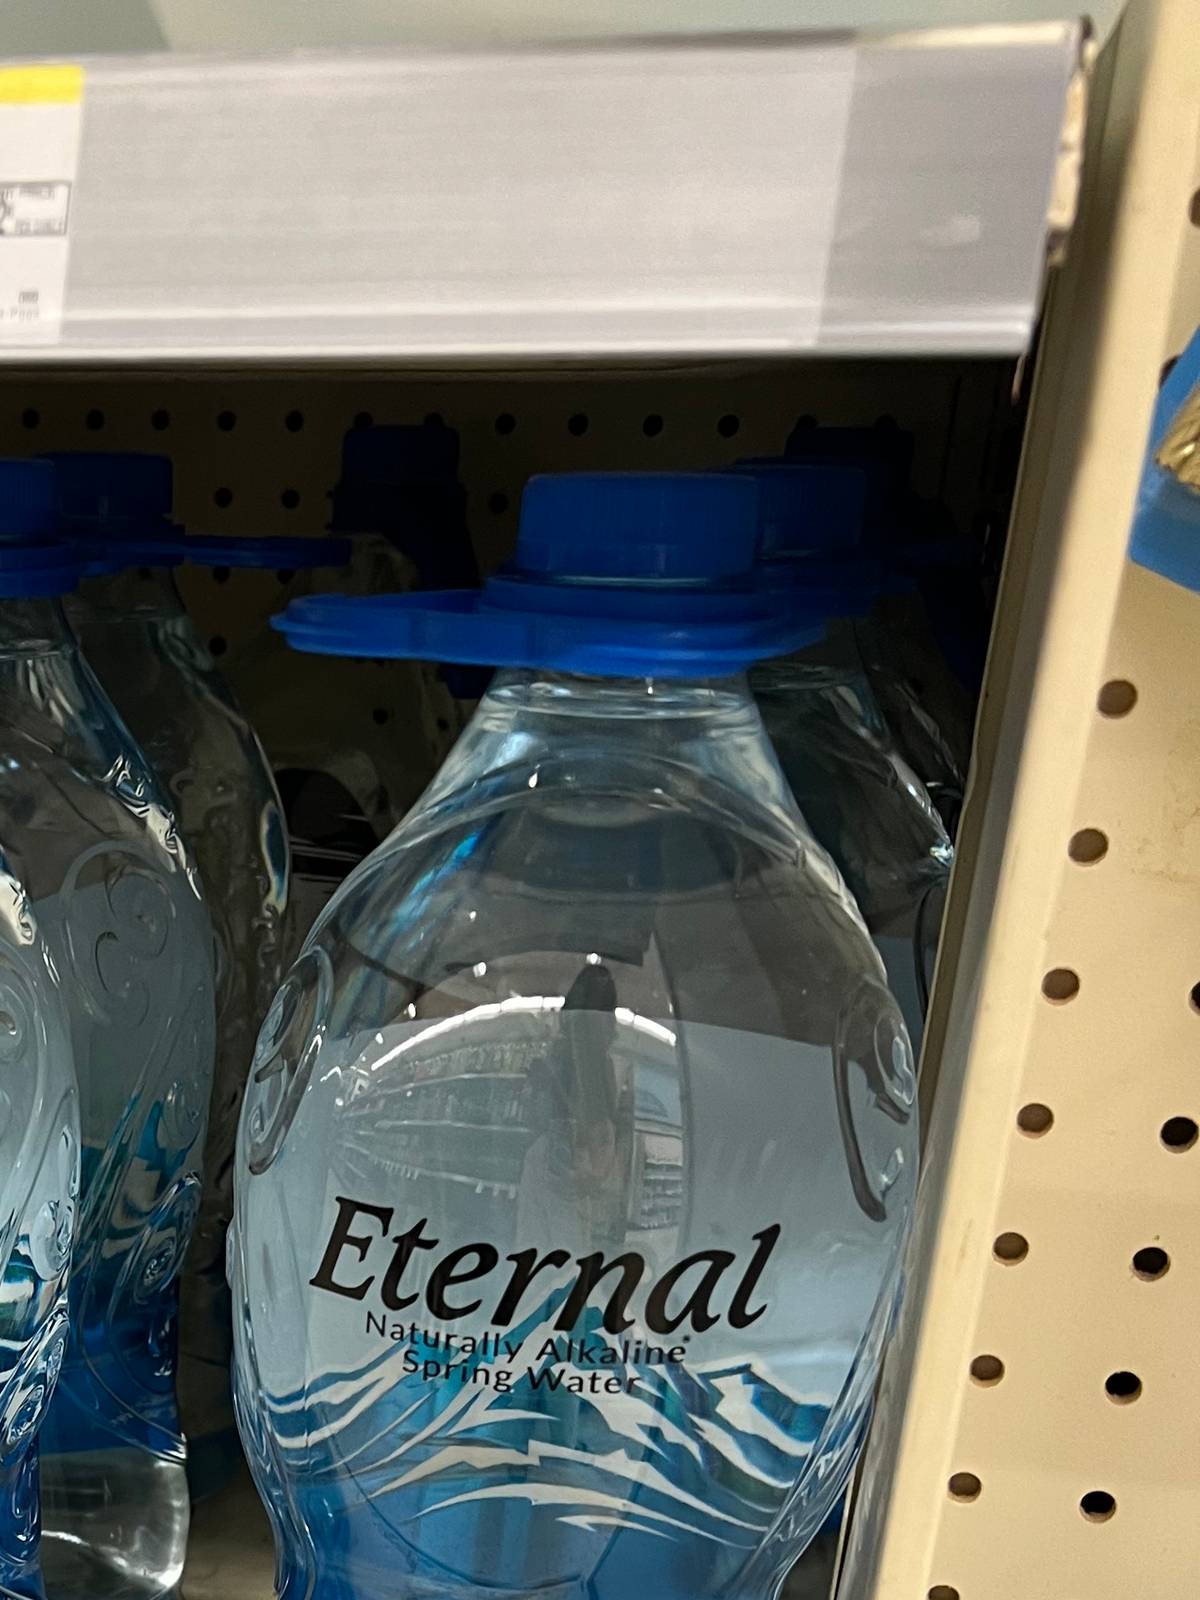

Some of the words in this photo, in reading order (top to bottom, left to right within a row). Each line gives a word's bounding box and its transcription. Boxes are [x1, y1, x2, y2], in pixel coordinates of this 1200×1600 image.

[309, 1196, 781, 1335] Eternal
[365, 1311, 522, 1363] Naturally
[536, 1337, 686, 1364] Alkaline
[403, 1350, 513, 1393] Spring
[528, 1367, 642, 1394] Water
